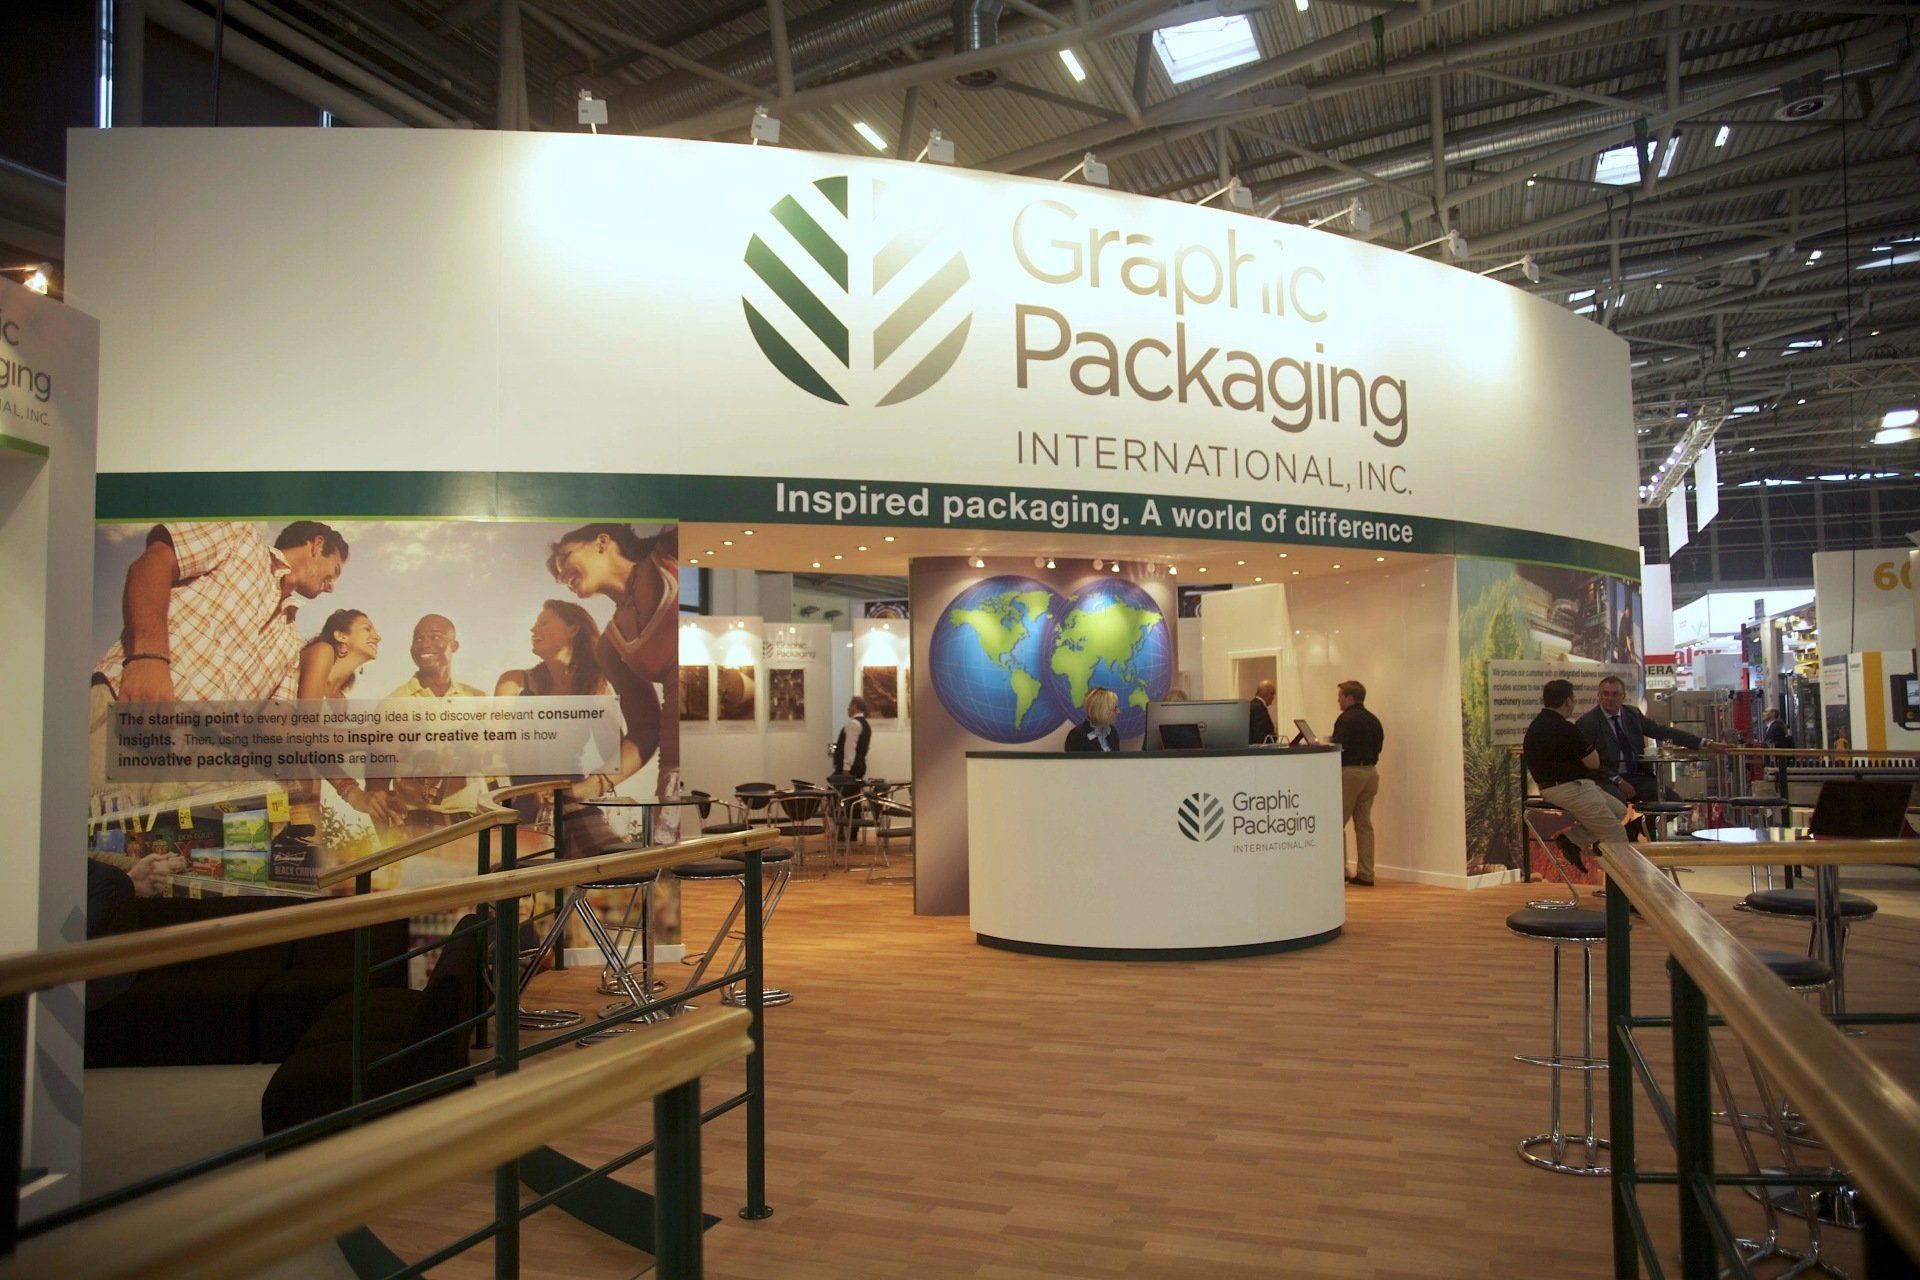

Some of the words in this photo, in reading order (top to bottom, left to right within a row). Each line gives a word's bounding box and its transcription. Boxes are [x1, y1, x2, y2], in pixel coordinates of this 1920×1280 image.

[1015, 303, 1409, 448] Packaging
[0, 399, 24, 421] AL,
[26, 406, 51, 428] INC.
[1017, 430, 1351, 494] INTERNATIONAL,
[1359, 461, 1413, 496] INC.
[776, 482, 930, 521] Inspired
[943, 492, 1129, 531] packaging.
[1140, 499, 1163, 527] A
[1171, 503, 1252, 532] world
[1261, 508, 1287, 534] of
[1295, 509, 1414, 544] difference
[1644, 665, 1674, 676] ERA
[119, 713, 144, 725] The
[148, 712, 201, 727] starting
[205, 711, 239, 727] point
[242, 713, 254, 724] to
[257, 714, 288, 726] every
[291, 713, 320, 726] great
[323, 711, 381, 726] packaging
[385, 709, 409, 722] idea
[412, 709, 422, 722] is
[425, 710, 436, 722] to
[440, 708, 487, 722] discover
[490, 708, 535, 721] relevant
[537, 707, 605, 720] consumer
[118, 733, 176, 747] insights.
[218, 733, 249, 747] using
[252, 731, 283, 745] these
[286, 731, 330, 746] insights
[333, 732, 344, 744] to
[347, 730, 393, 744] inspire
[398, 731, 421, 743] our
[425, 729, 479, 742] creative
[483, 729, 518, 742] team
[521, 729, 531, 741] is
[534, 727, 558, 741] how
[118, 752, 192, 767] innovative
[197, 751, 273, 769] packaging
[277, 750, 345, 765] solutions
[348, 753, 367, 764] are
[370, 751, 400, 764] born.
[1232, 789, 1300, 813] Graphic
[1233, 812, 1316, 836] Packaging
